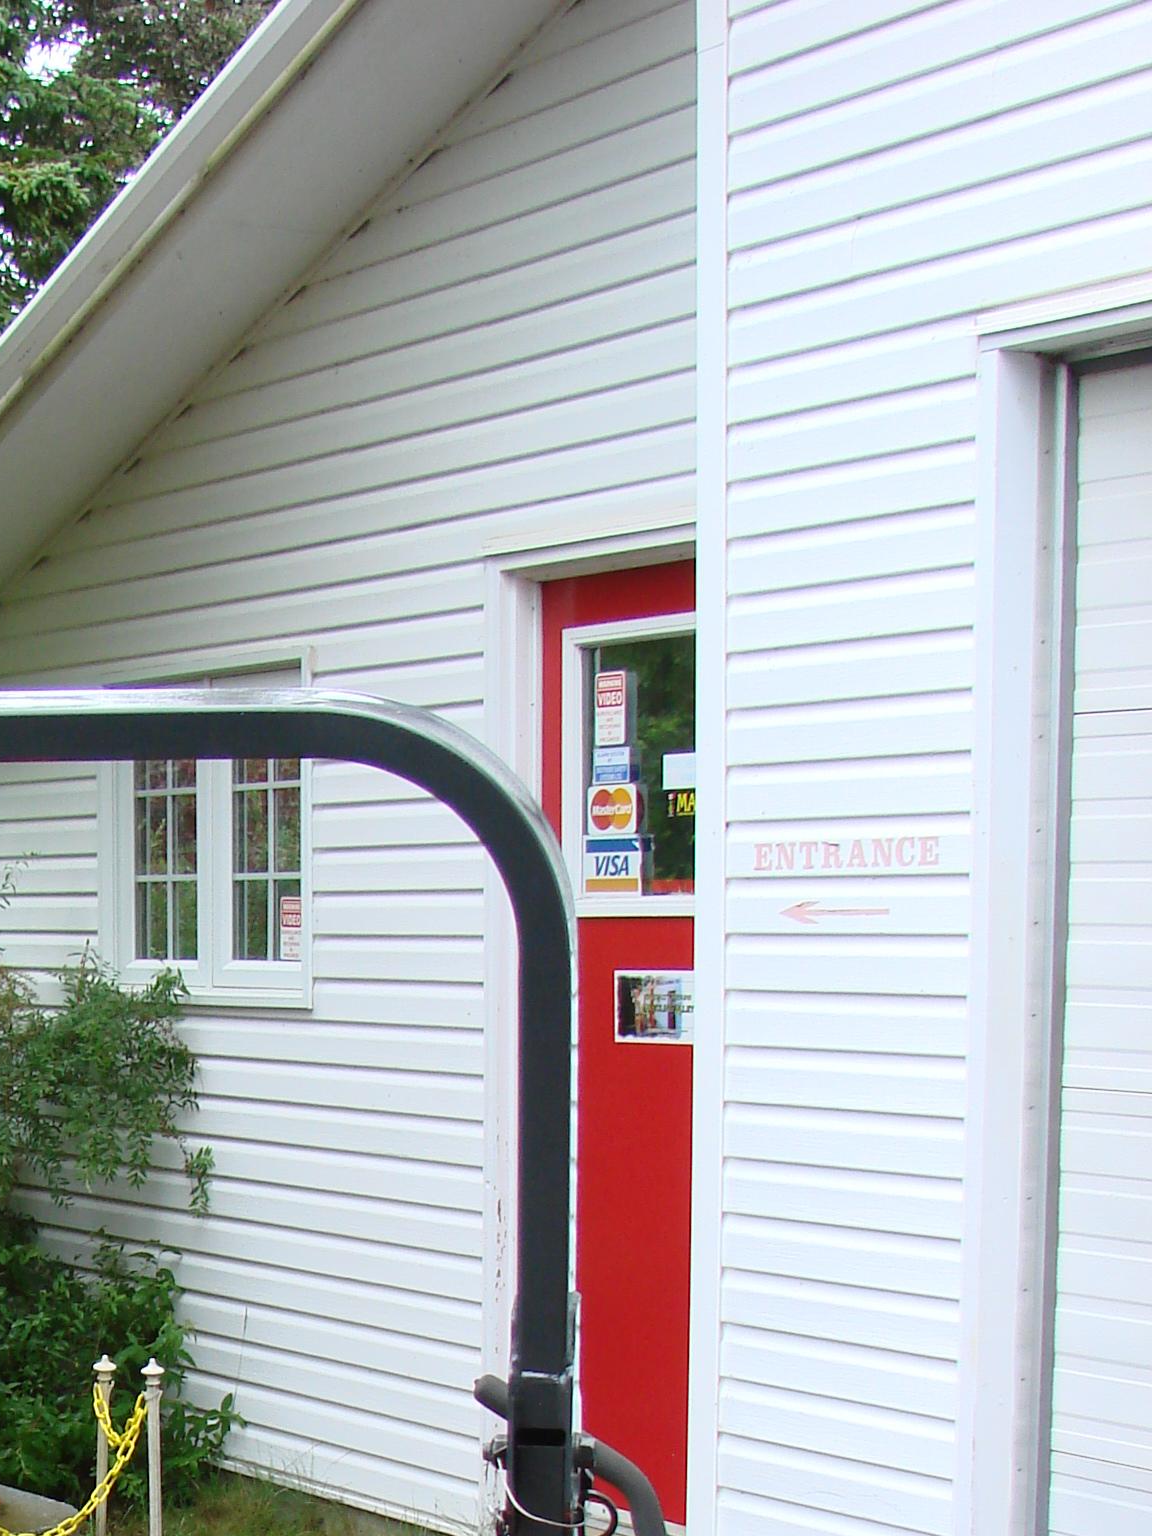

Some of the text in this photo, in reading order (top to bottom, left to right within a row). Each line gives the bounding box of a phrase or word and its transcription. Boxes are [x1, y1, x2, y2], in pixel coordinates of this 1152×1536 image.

[598, 690, 623, 706] VIDEO
[753, 836, 941, 871] ENTRANCE
[594, 855, 630, 877] VISA
